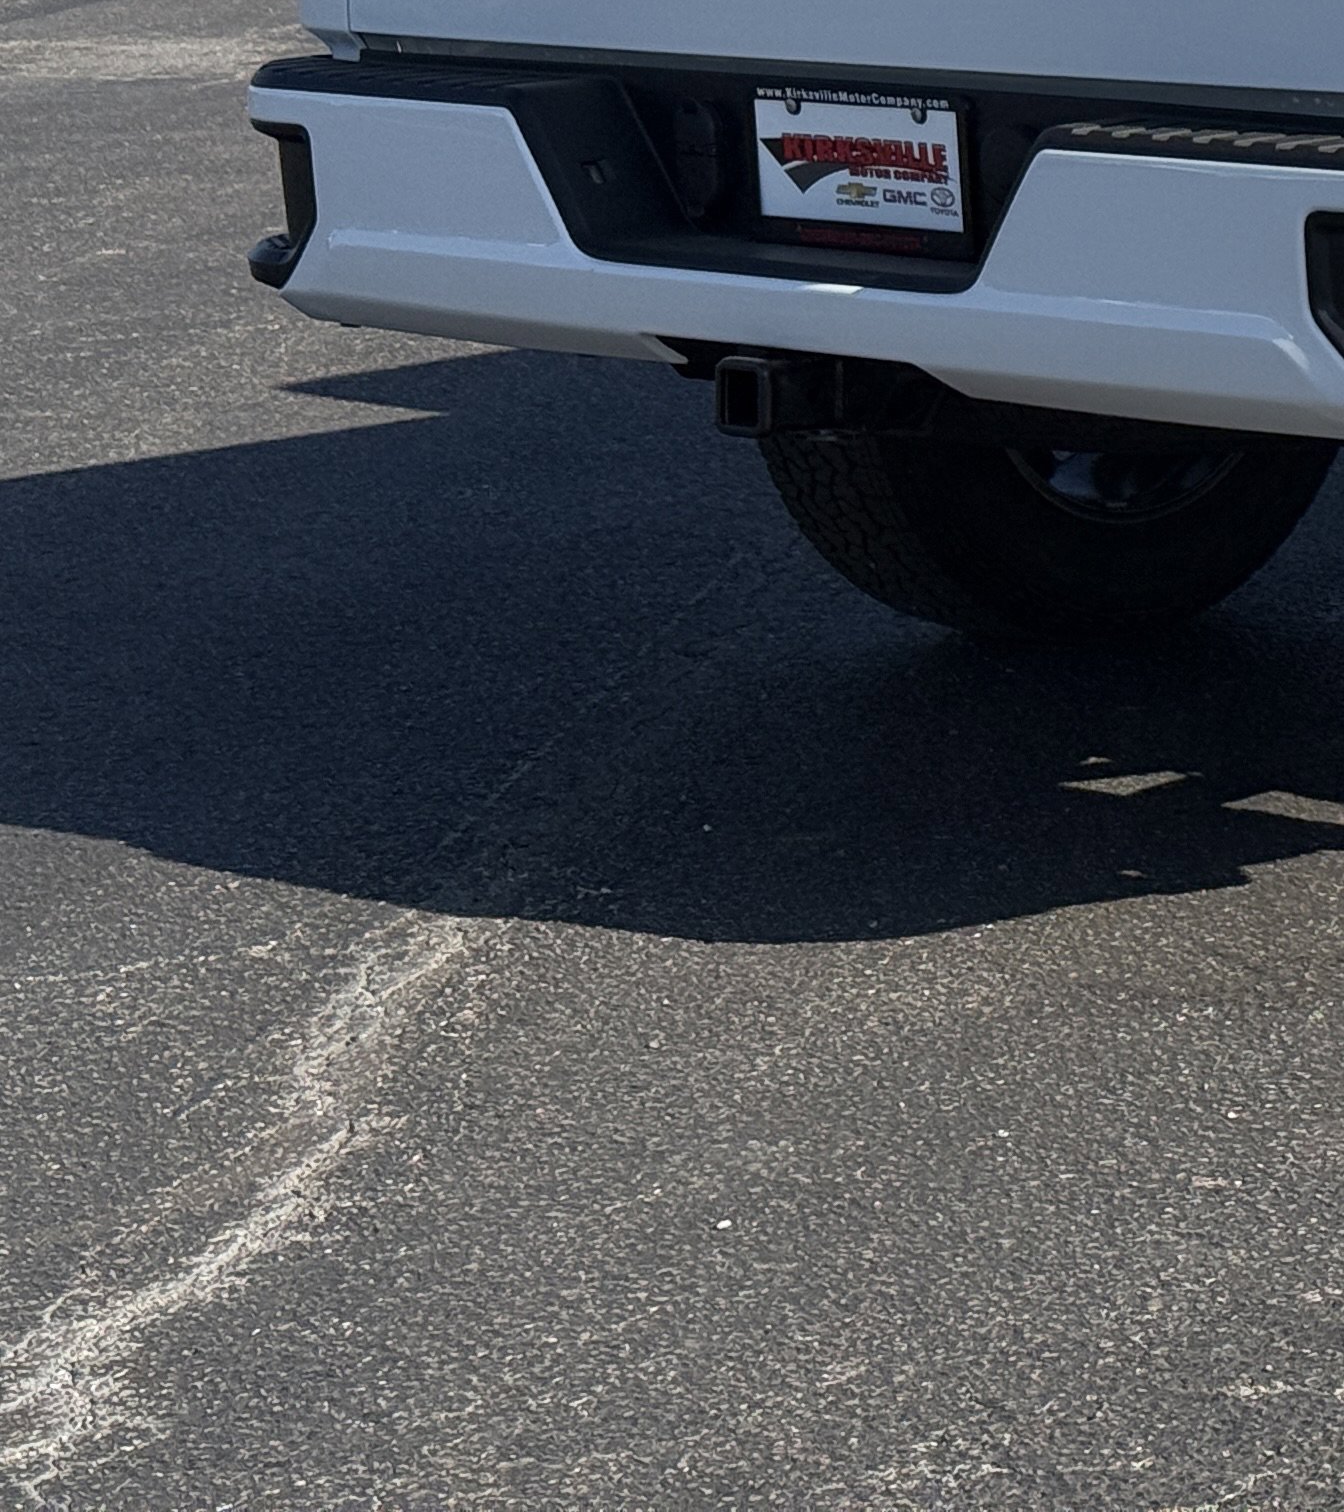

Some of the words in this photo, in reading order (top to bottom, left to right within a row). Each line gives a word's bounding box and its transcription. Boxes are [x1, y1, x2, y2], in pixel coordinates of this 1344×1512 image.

[756, 87, 950, 110] www.KirksvilleMotorCompany.com
[781, 133, 947, 173] KIRKSVILLE
[836, 197, 880, 209] CHEVROLET
[882, 189, 928, 207] GMC
[930, 207, 960, 218] TOYOTA
